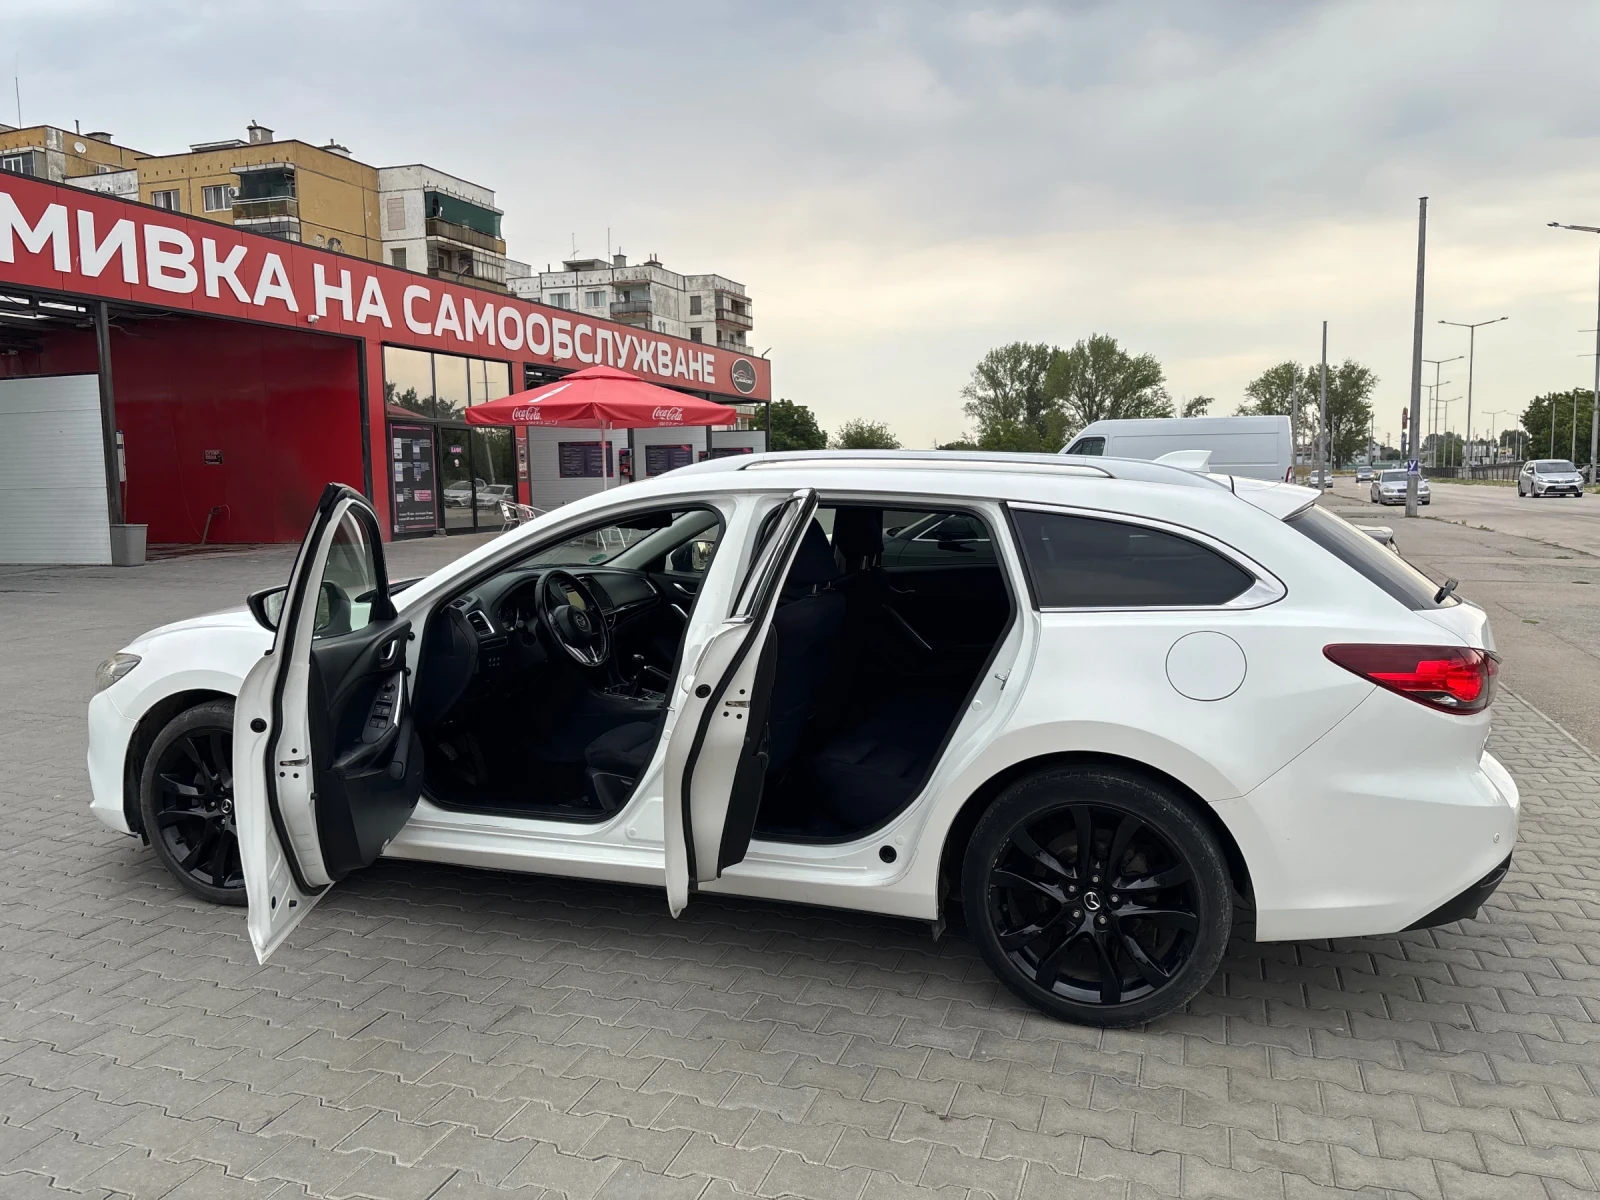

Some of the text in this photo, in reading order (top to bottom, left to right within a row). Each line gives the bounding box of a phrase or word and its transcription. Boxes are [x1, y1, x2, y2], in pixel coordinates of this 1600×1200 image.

[0, 191, 716, 384] МИВКА НА САМООБСЛУЖВАНЕ
[512, 406, 542, 421] Coca-Cola
[652, 406, 684, 421] Coca-Cola
